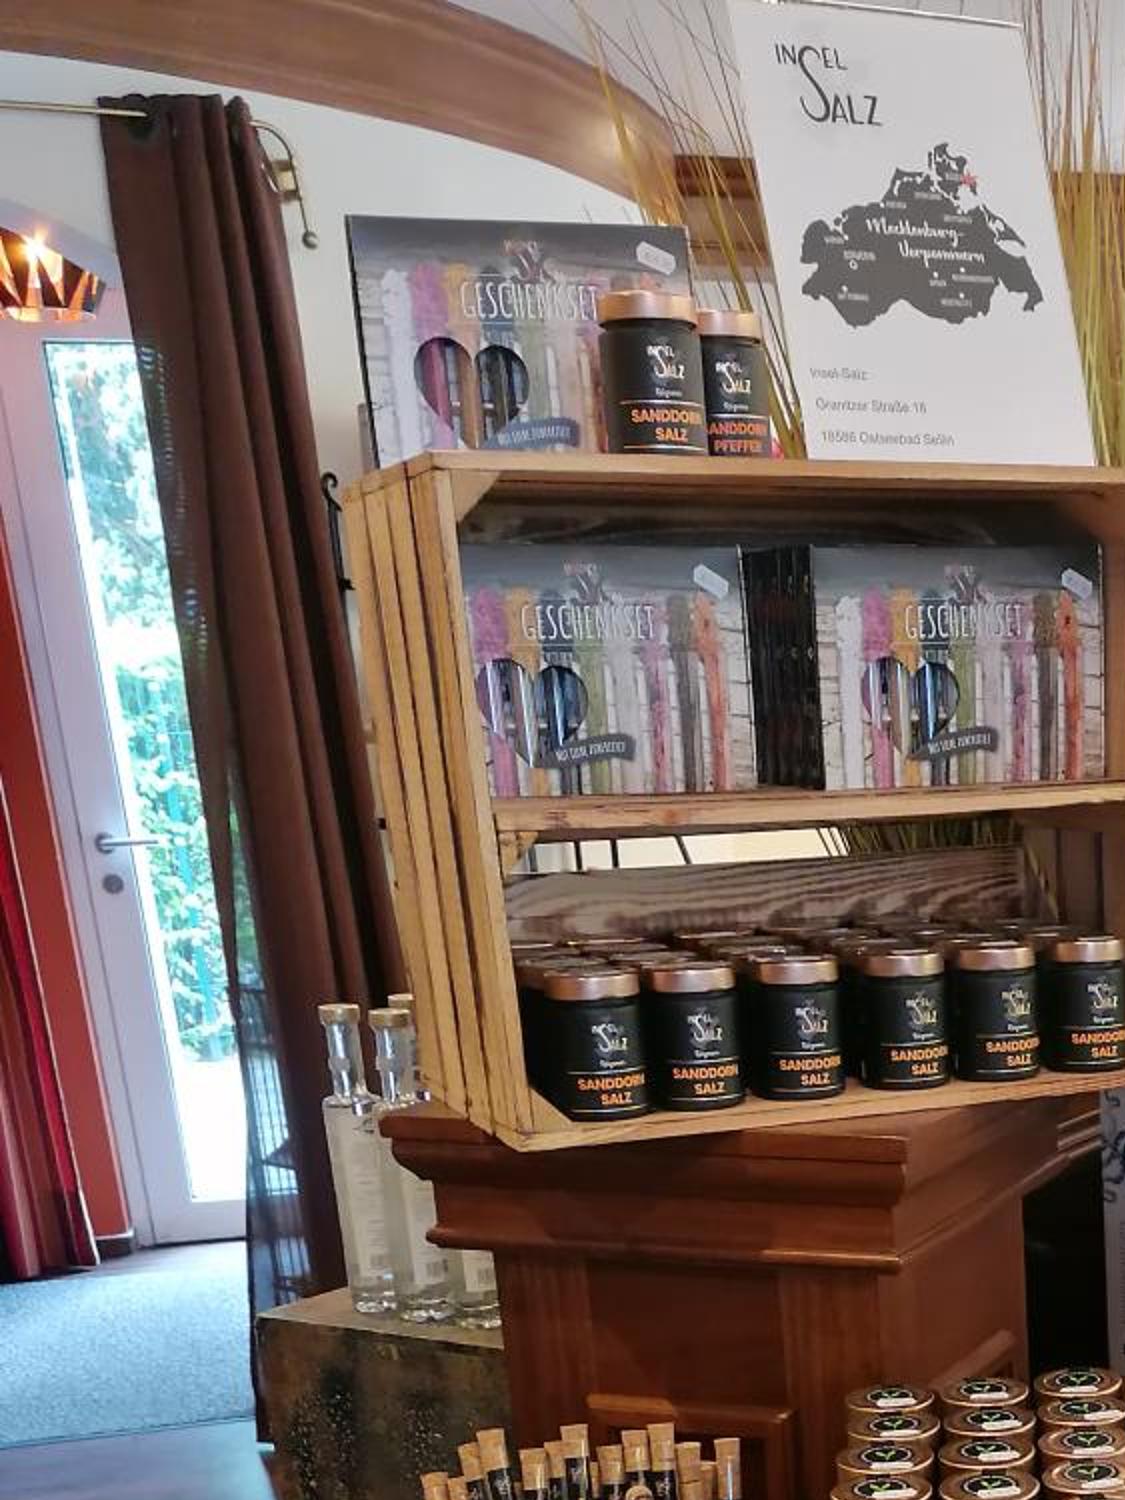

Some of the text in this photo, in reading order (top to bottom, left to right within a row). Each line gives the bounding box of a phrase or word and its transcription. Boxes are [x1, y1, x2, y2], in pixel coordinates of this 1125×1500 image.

[655, 427, 689, 442] SALZ
[800, 1072, 831, 1086] SALZ
[695, 1081, 726, 1096] SALZ
[601, 1091, 633, 1106] SALZ
